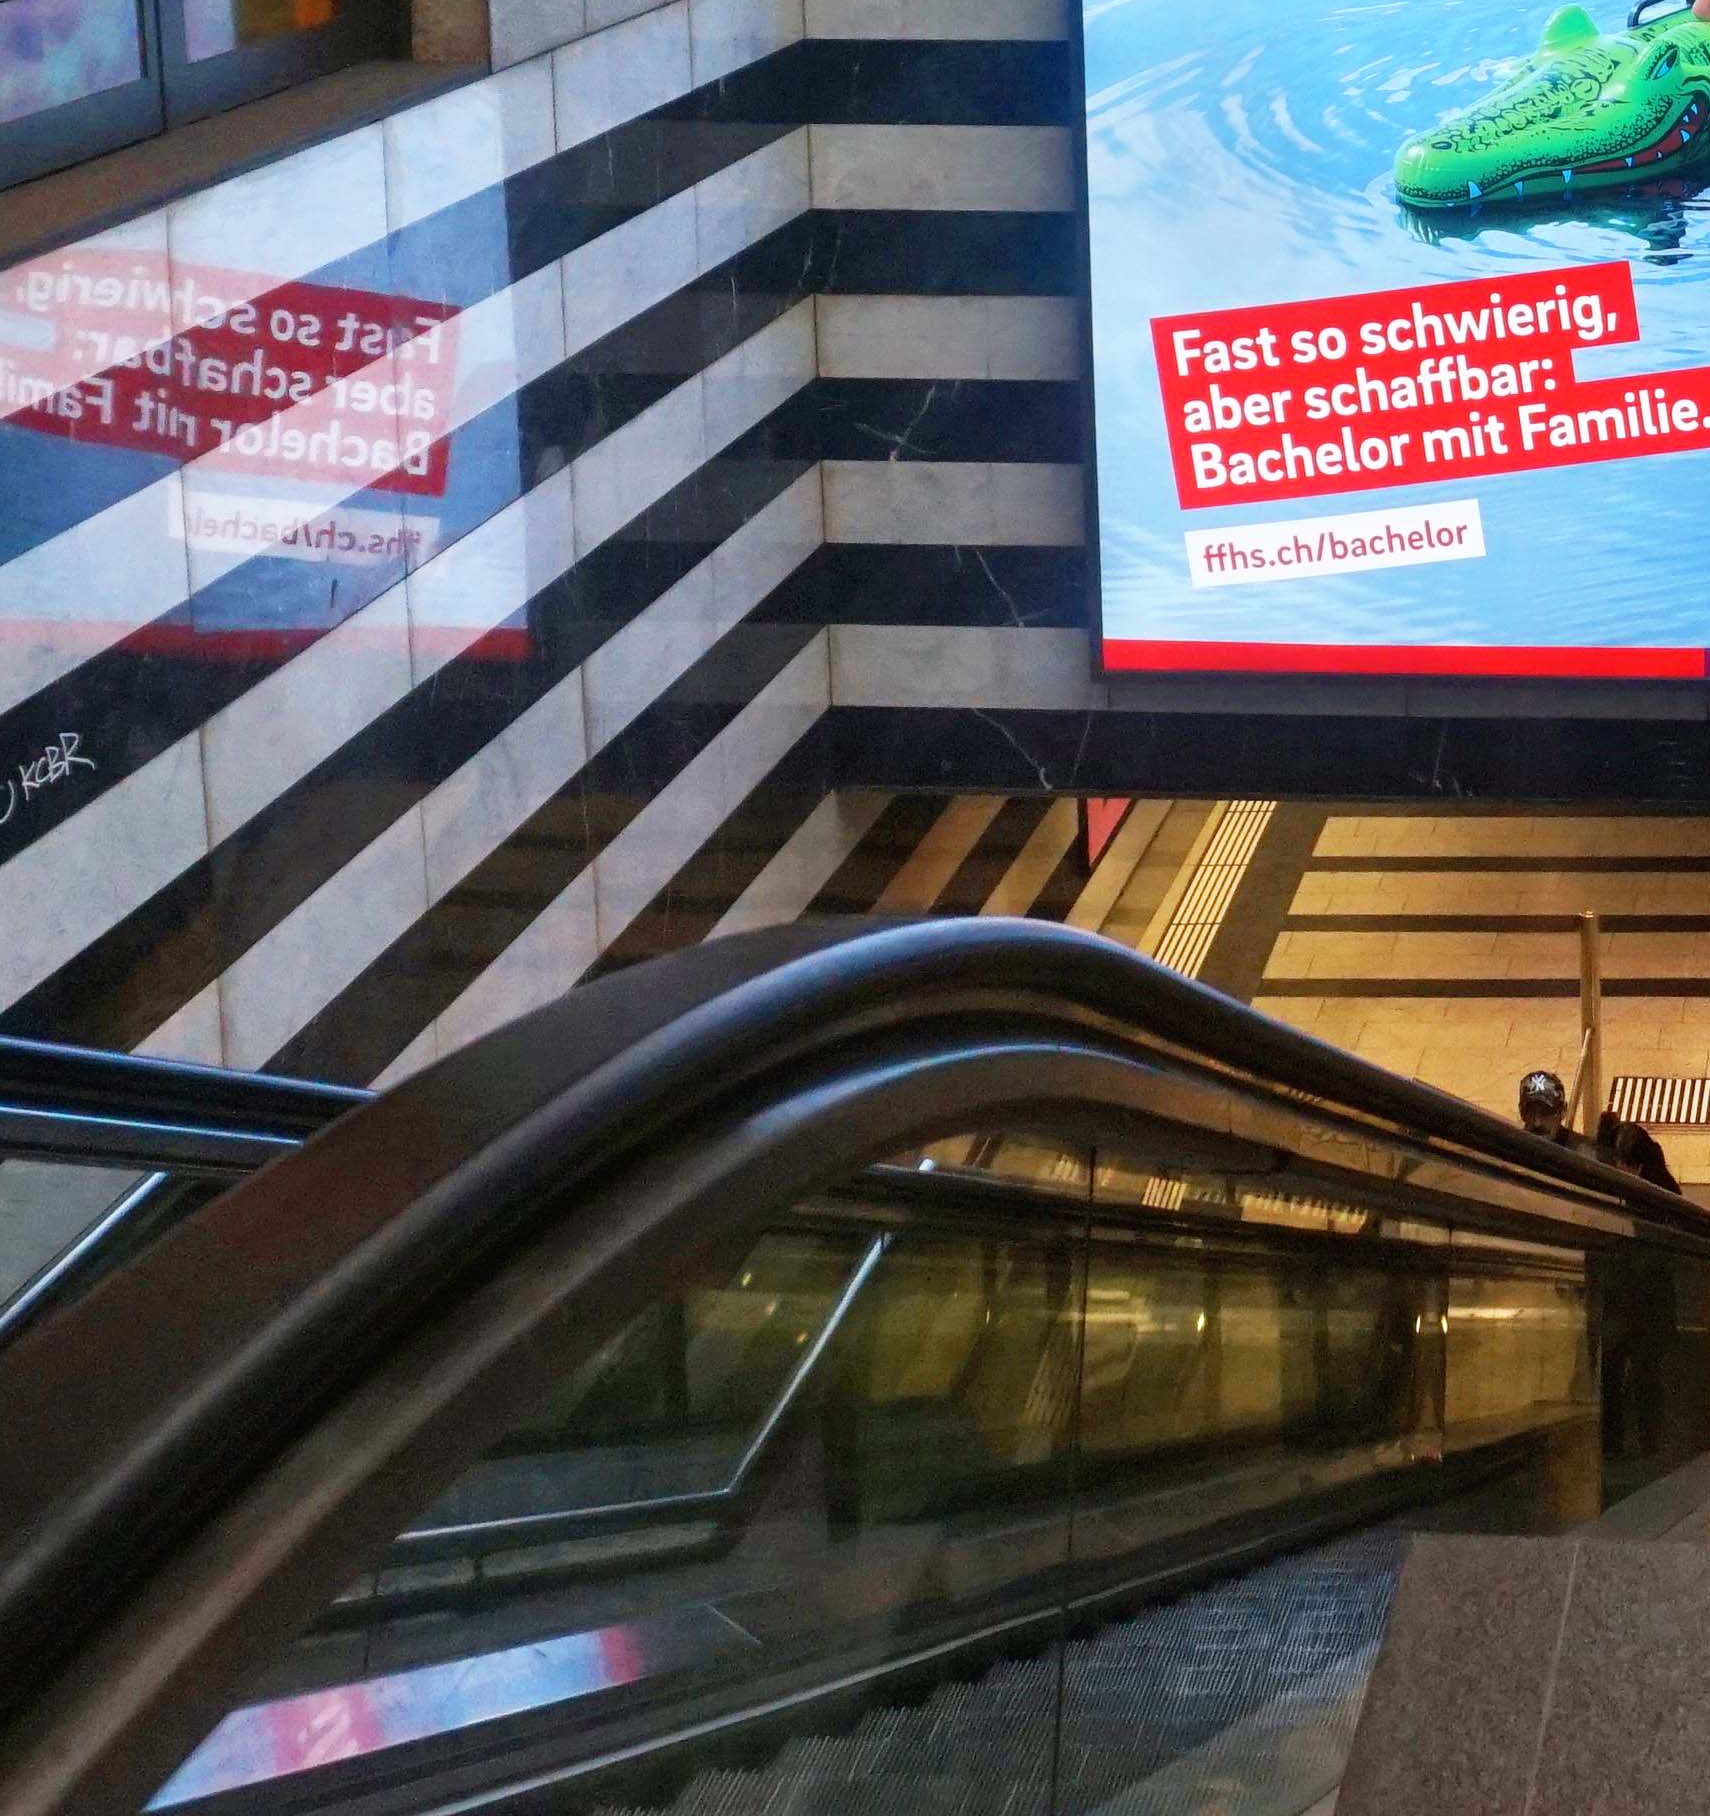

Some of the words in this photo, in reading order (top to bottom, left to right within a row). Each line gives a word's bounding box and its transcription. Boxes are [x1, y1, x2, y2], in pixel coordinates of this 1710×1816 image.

[1172, 327, 1281, 377] Fast
[1291, 326, 1348, 365] so
[1359, 285, 1618, 352] schwierig,
[1183, 382, 1292, 433] aber
[1303, 353, 1557, 420] schaffbar:
[1190, 424, 1411, 489] Bachelor
[1422, 411, 1508, 463] mit
[1202, 517, 1469, 573] ffhs.ch/bachelor
